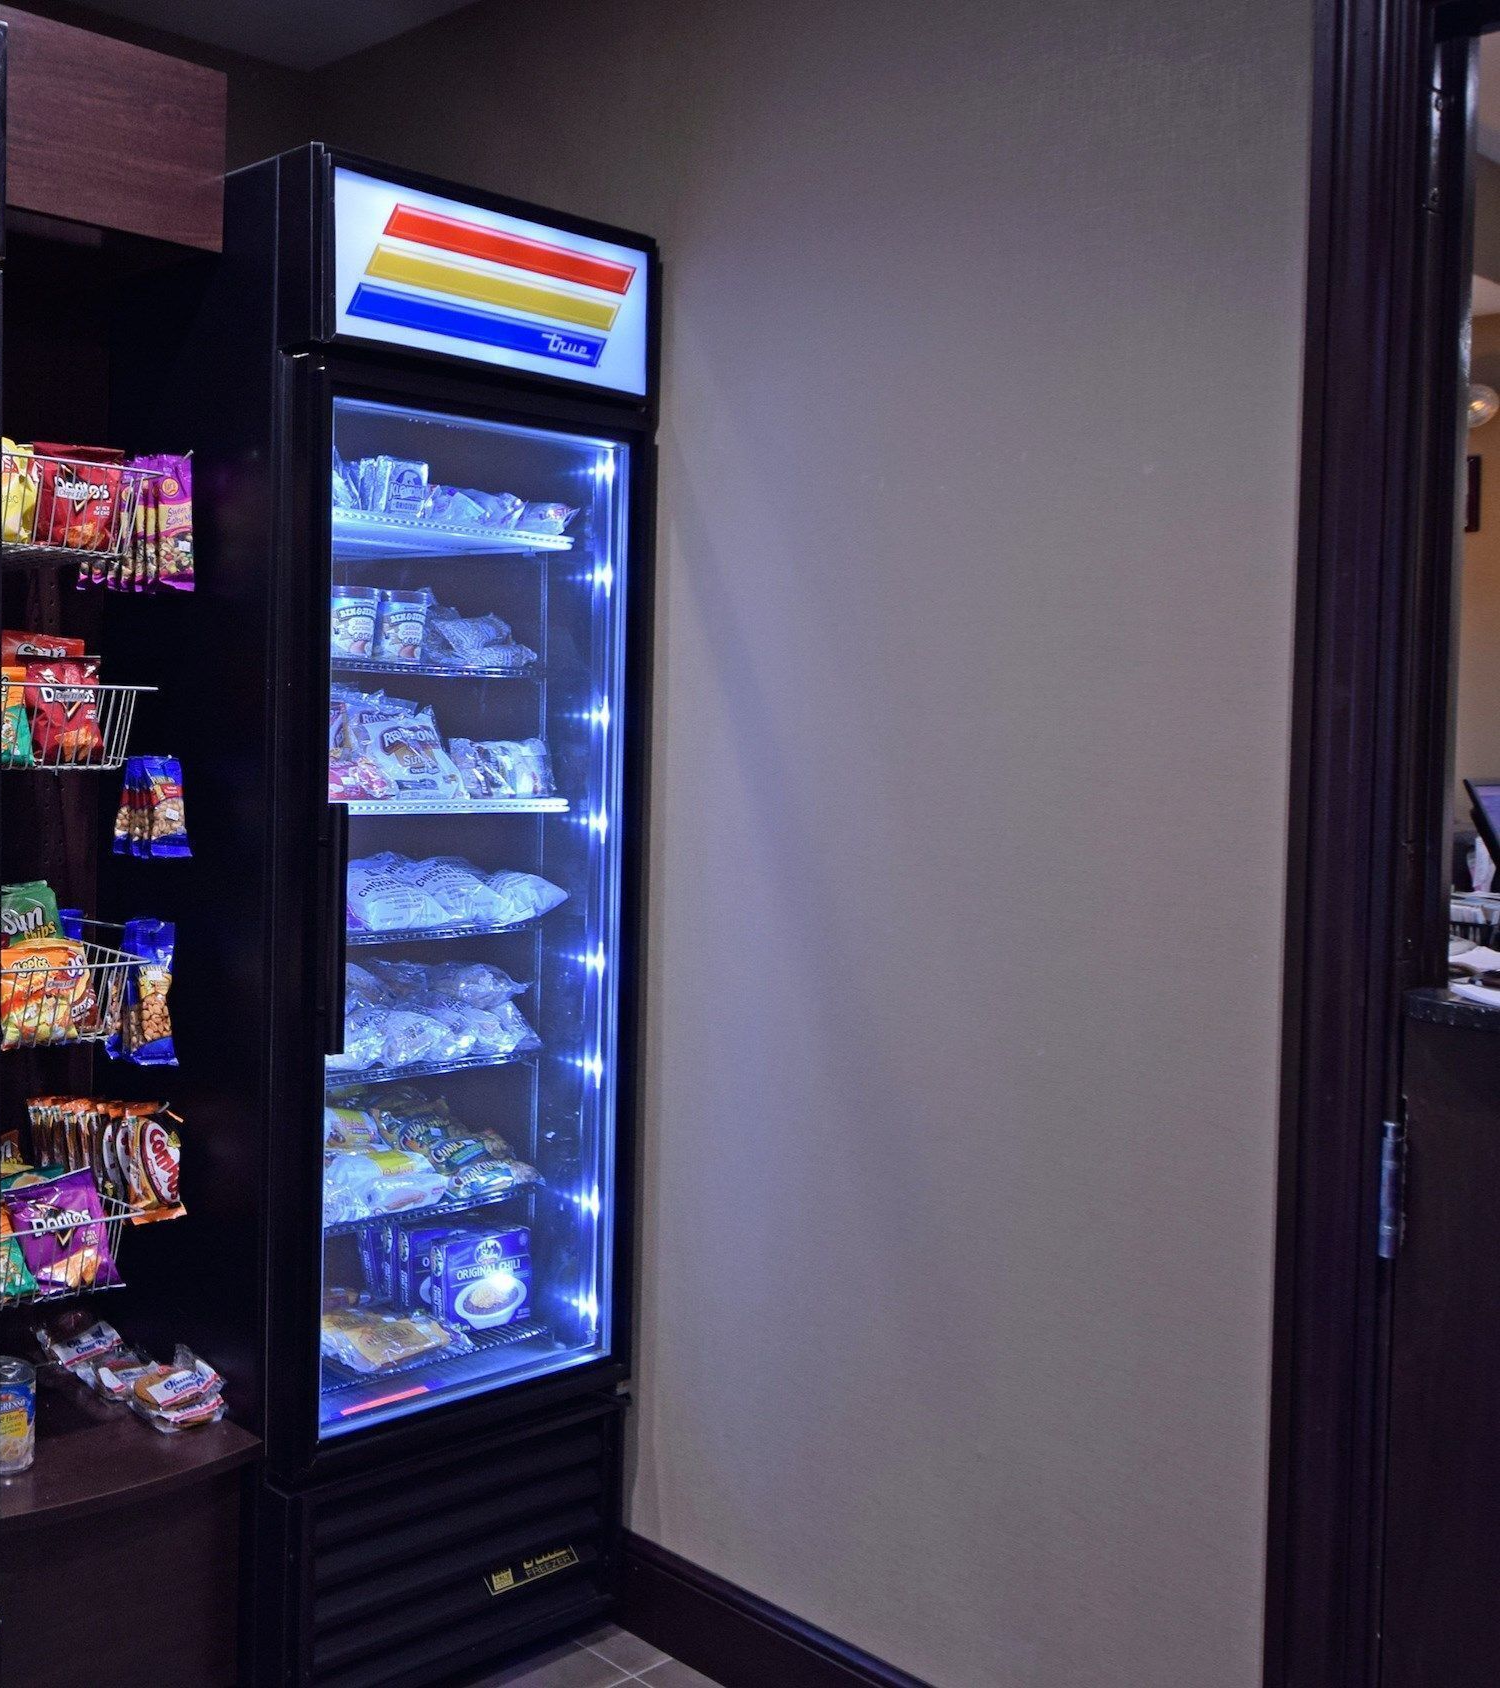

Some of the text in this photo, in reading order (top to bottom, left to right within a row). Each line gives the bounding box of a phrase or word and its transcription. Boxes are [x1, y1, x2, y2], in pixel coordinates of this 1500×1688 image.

[2, 906, 44, 935] Sun
[23, 921, 56, 940] Chips
[31, 1209, 92, 1238] Doritos
